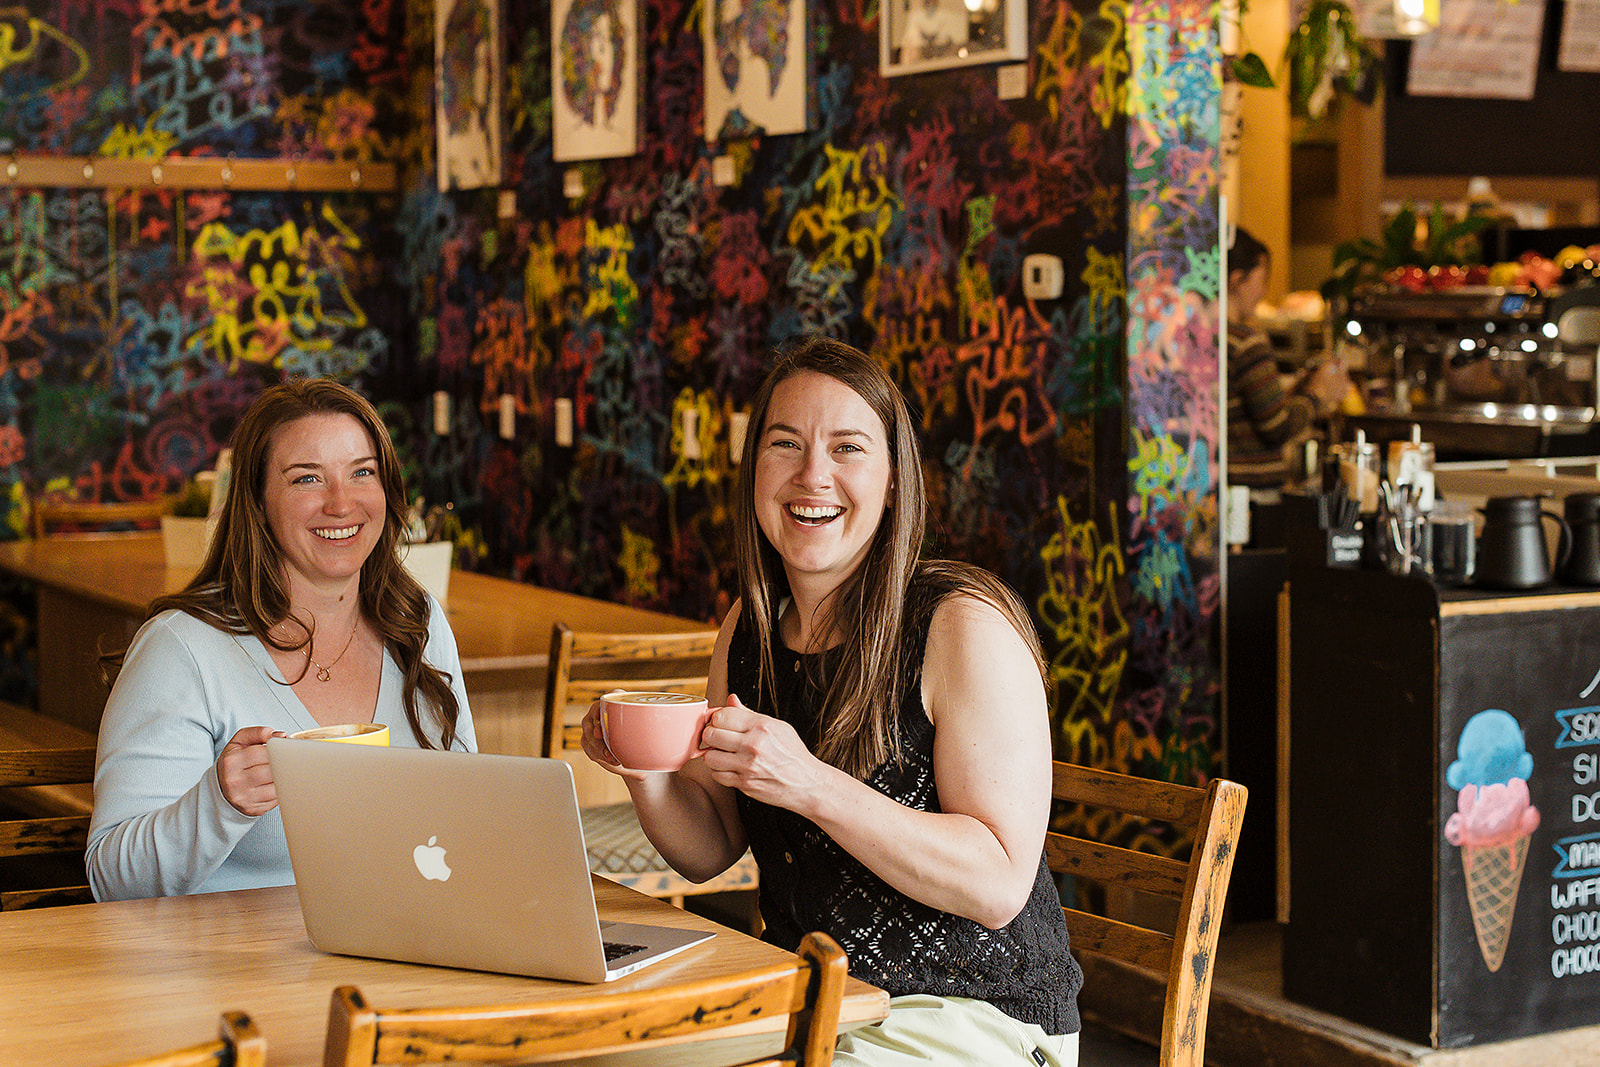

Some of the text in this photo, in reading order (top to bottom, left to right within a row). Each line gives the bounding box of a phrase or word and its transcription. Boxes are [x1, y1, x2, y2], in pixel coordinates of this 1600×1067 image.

[1570, 712, 1600, 742] SC
[1572, 752, 1600, 785] SI
[1569, 841, 1600, 868] MA
